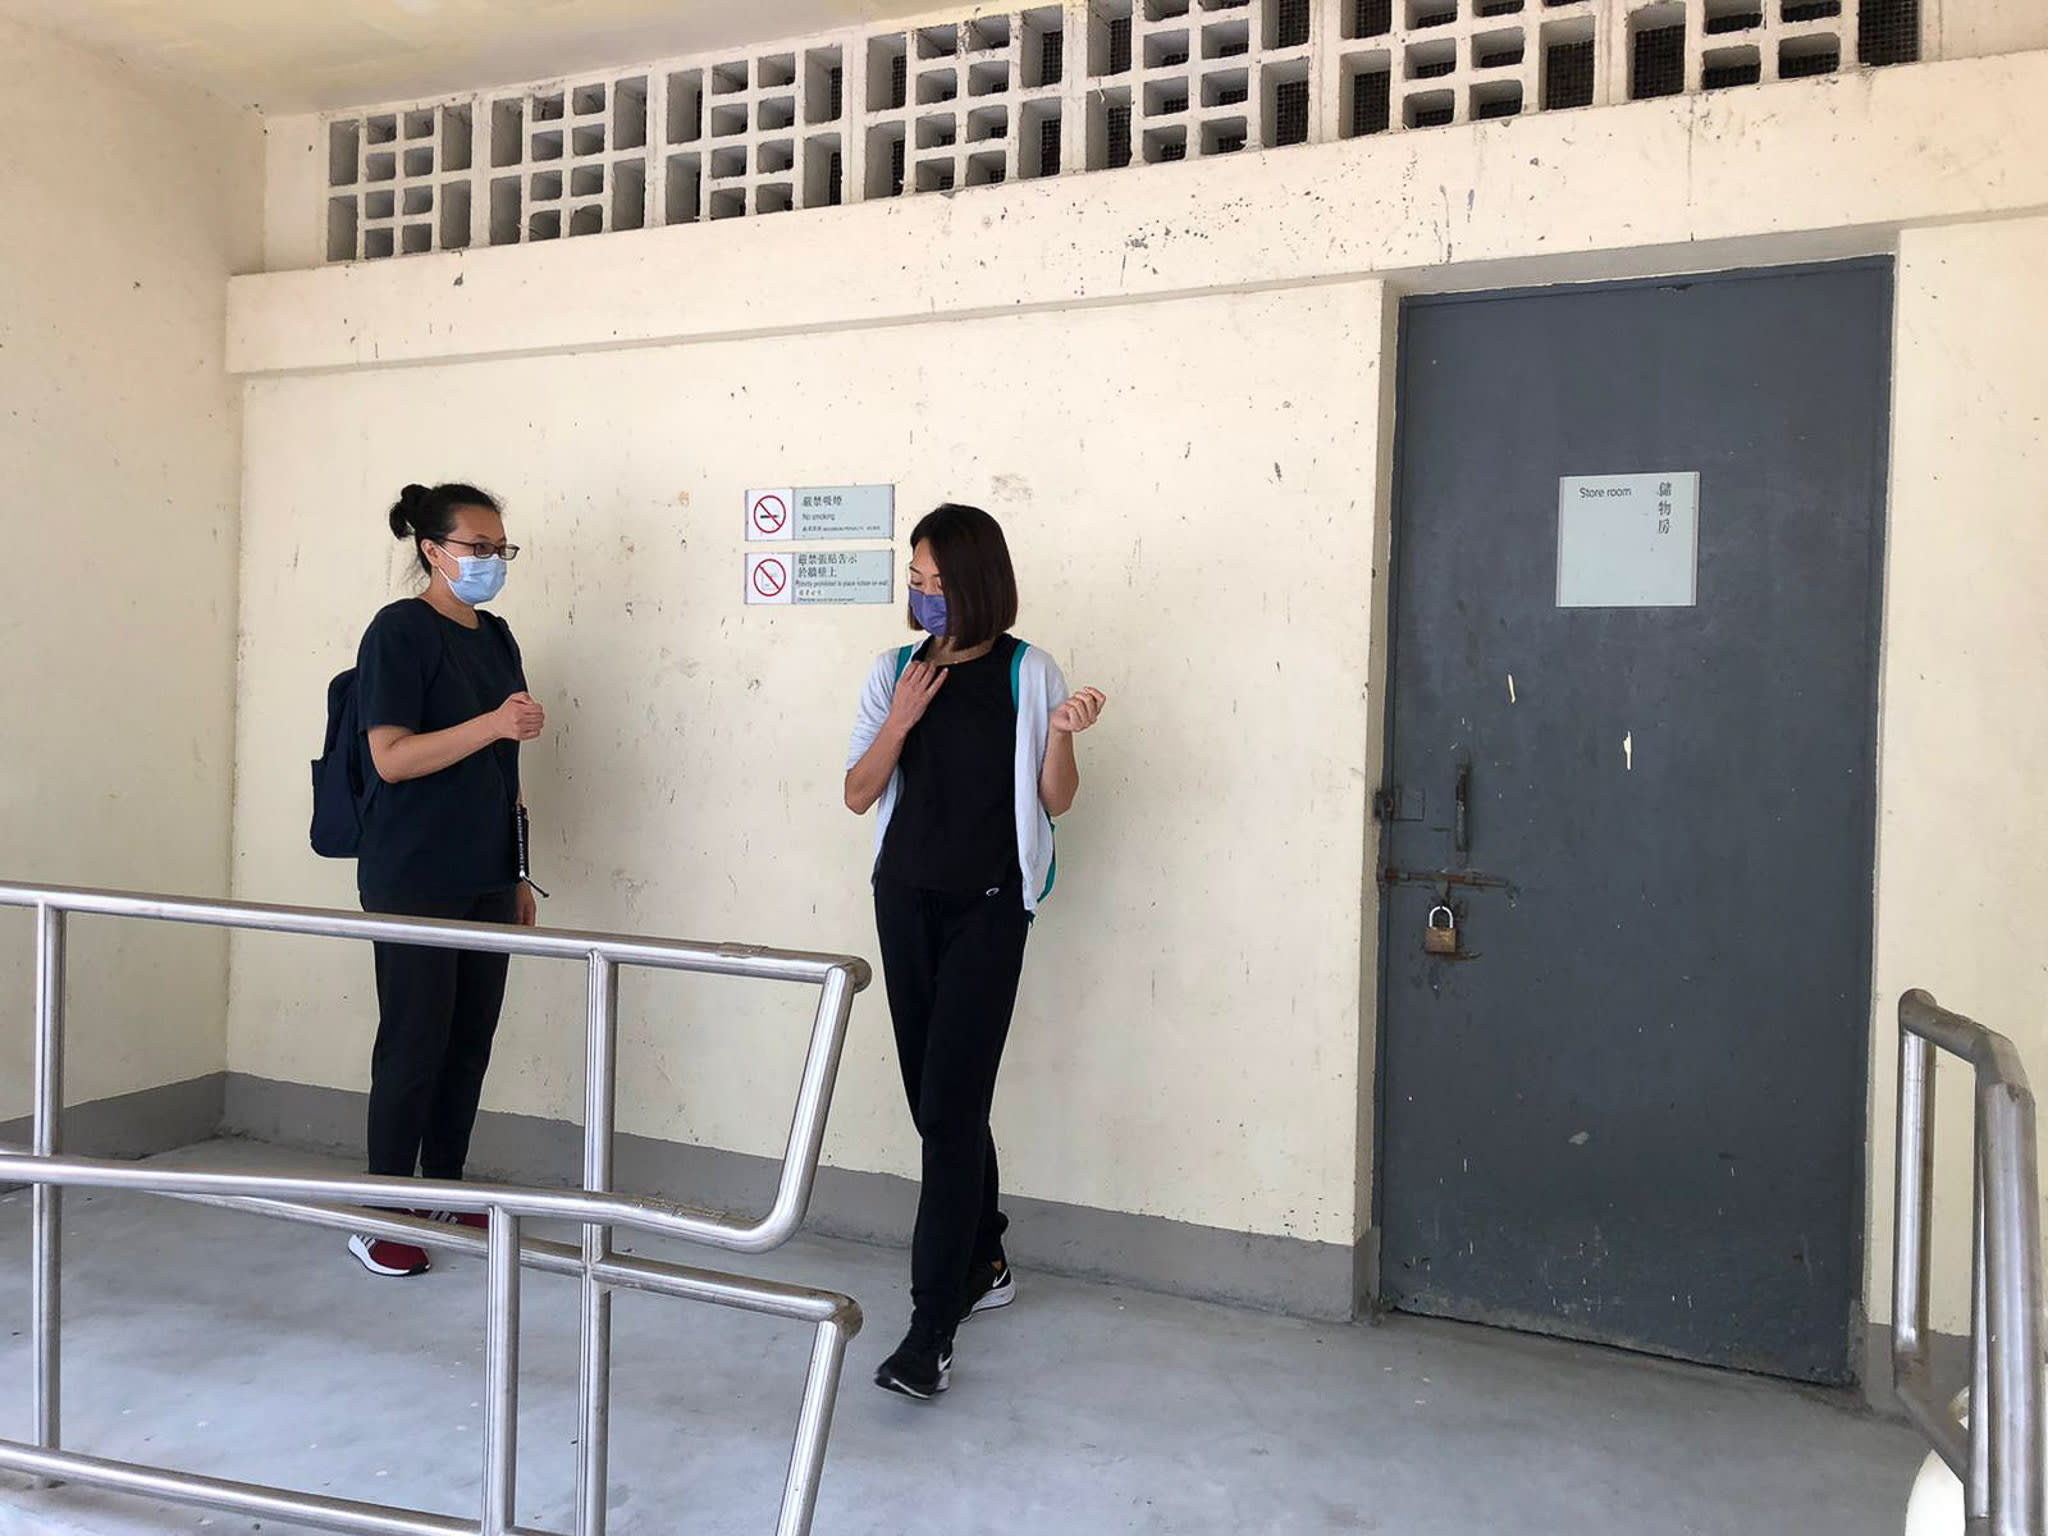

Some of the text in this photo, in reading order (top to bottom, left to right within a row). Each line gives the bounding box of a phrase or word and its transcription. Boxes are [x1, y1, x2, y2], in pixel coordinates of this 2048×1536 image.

[1579, 487, 1632, 498] Store room
[1658, 481, 1672, 535] 儲物房
[802, 513, 836, 521] No smoking
